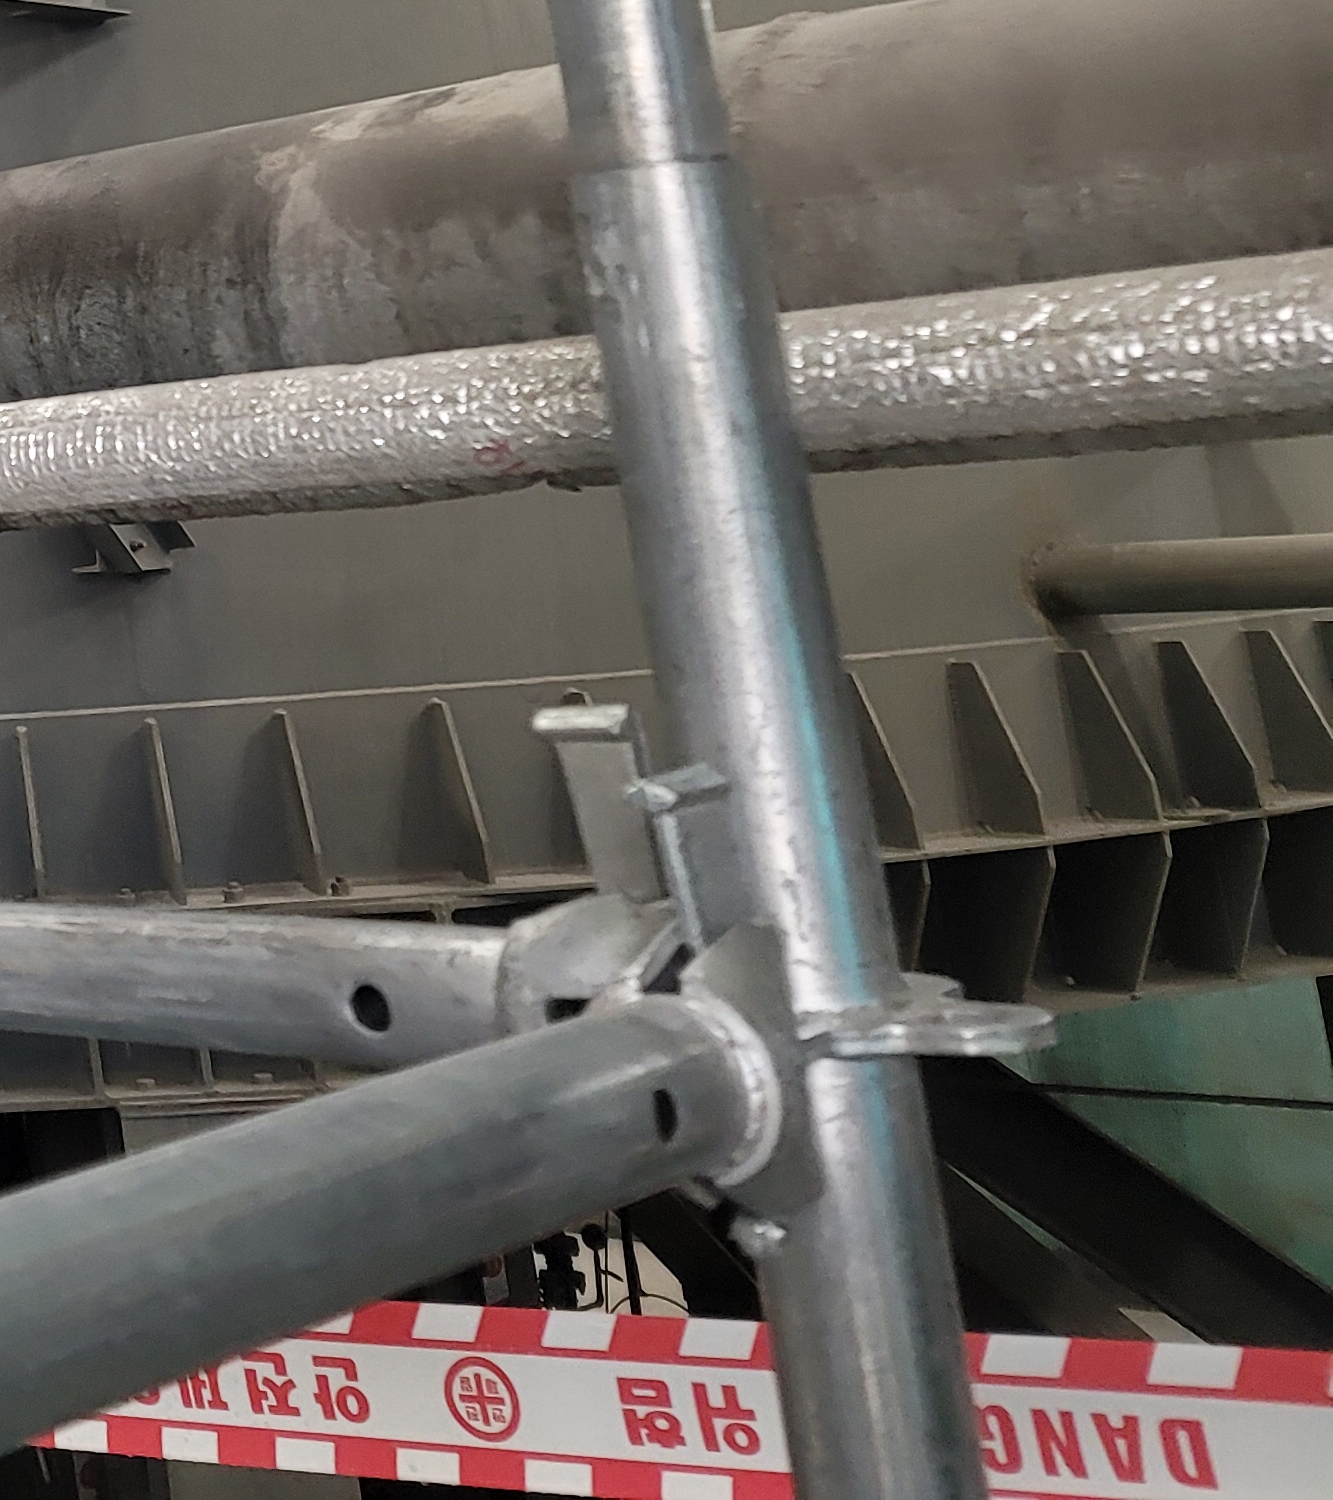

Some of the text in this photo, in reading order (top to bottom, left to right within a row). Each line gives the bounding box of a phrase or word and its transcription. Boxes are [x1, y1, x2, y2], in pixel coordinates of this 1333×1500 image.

[132, 1351, 1220, 1491] DANG 위험 안전제
